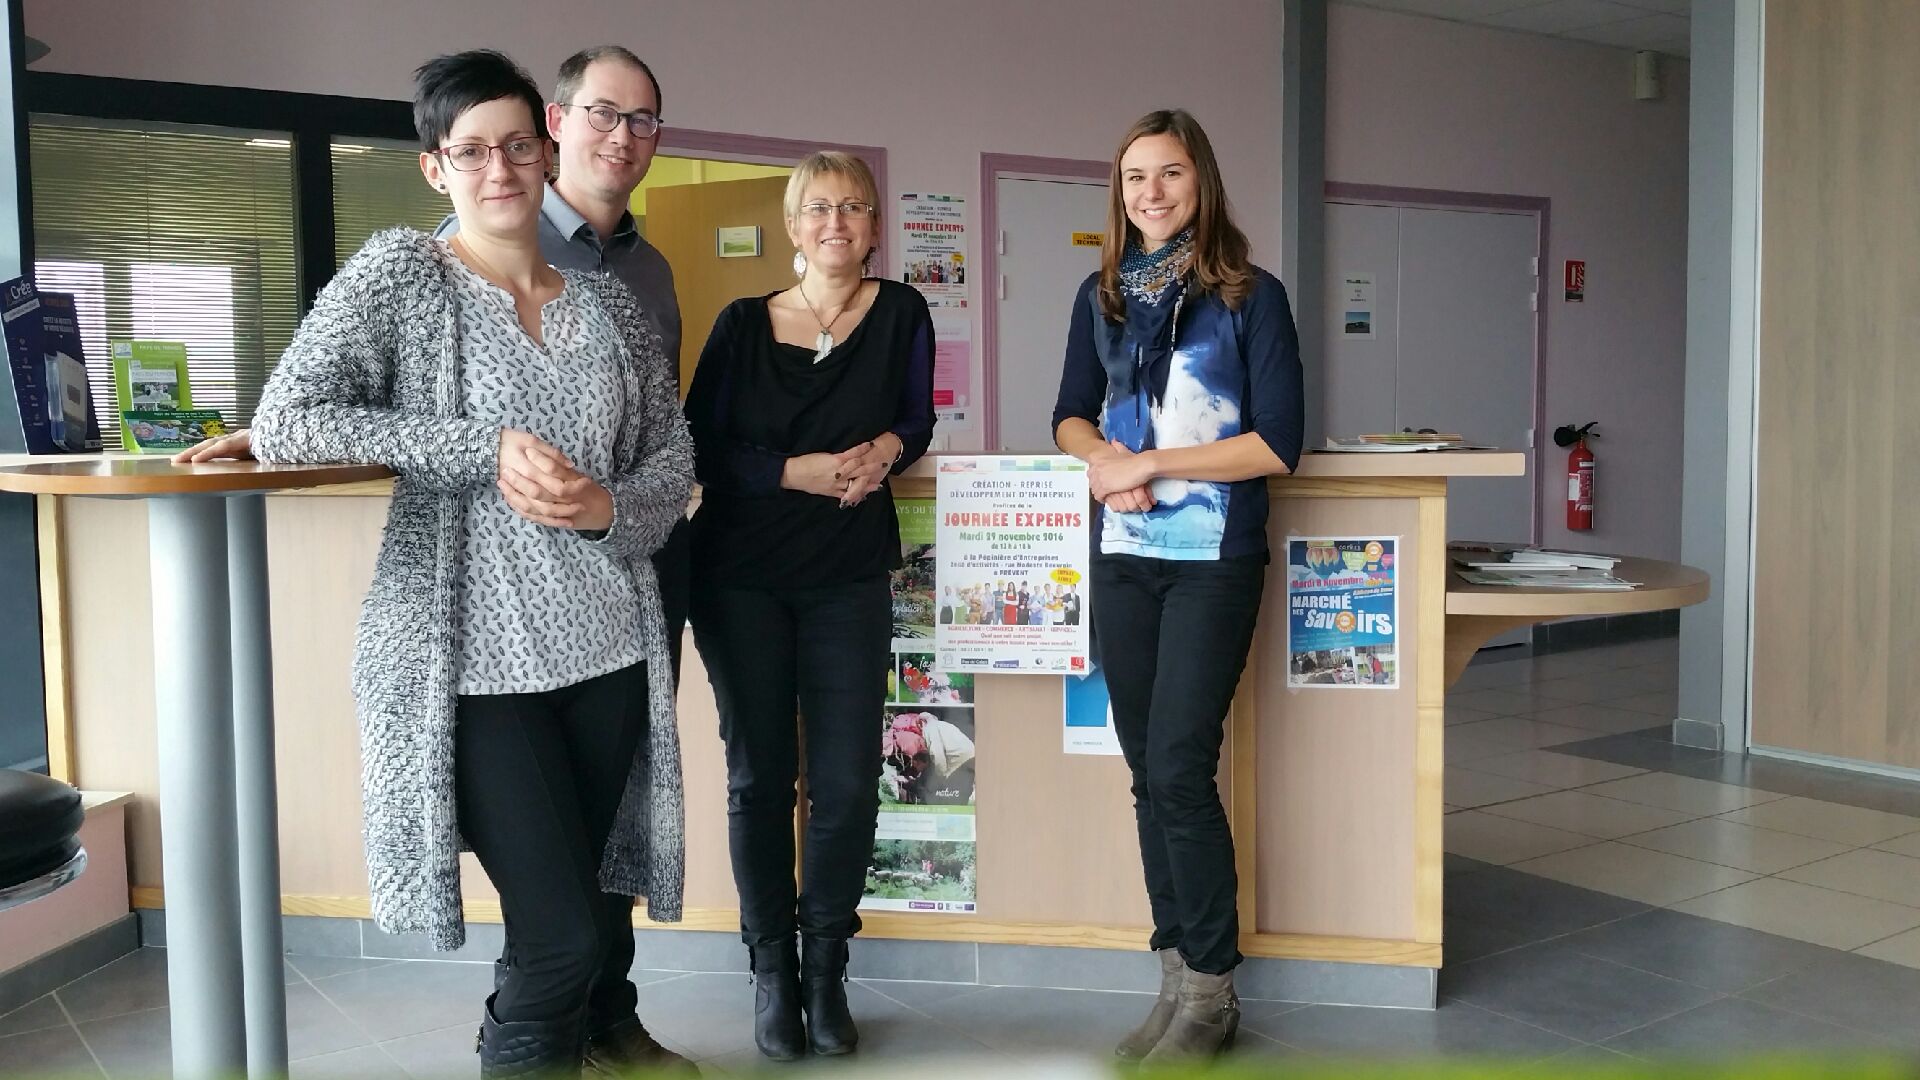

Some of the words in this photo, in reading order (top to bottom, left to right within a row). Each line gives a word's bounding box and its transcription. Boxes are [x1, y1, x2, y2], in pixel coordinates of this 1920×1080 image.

[936, 223, 964, 232] EXPERTS
[972, 480, 1011, 488] CRÉATION
[950, 490, 1016, 498] DÉVELOPPEMENT
[913, 506, 925, 514] DU
[945, 510, 1008, 527] JOURNÉE
[1016, 512, 1081, 527] EXPERTS
[960, 532, 983, 541] Mardi
[986, 532, 996, 541] 29
[999, 532, 1040, 541] novembre
[1043, 532, 1063, 541] 2016
[1292, 593, 1352, 610] MARCHÉ
[935, 787, 960, 798] nature
